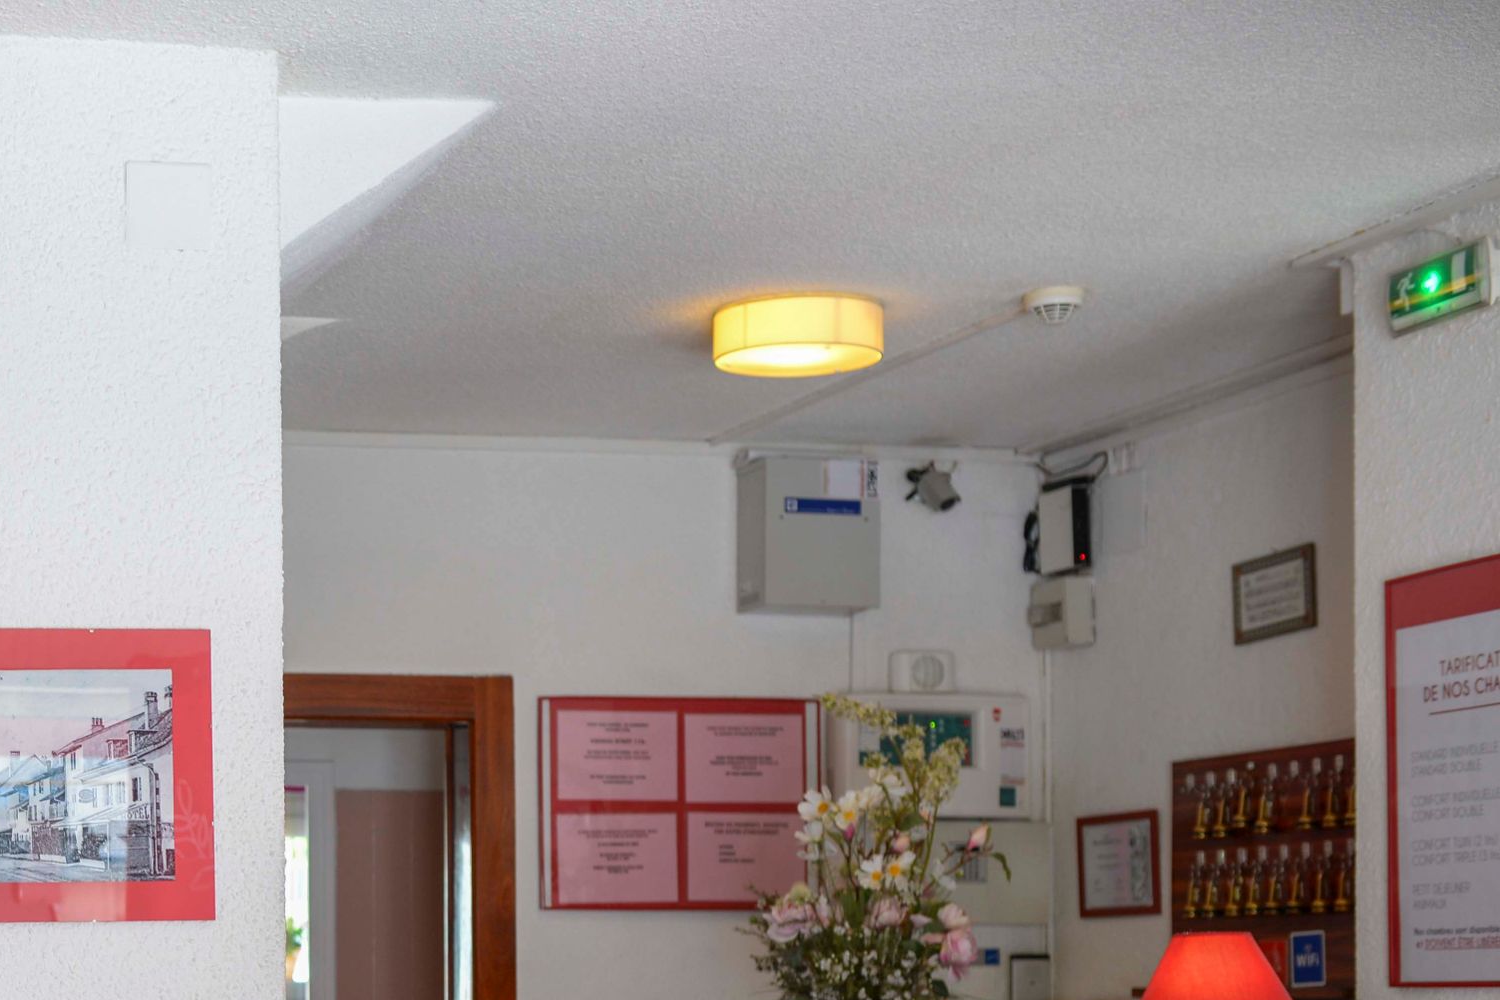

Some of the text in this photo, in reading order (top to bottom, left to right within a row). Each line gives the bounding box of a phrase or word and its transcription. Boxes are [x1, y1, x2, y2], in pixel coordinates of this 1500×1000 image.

[1423, 674, 1500, 703] DE NOS CHA
